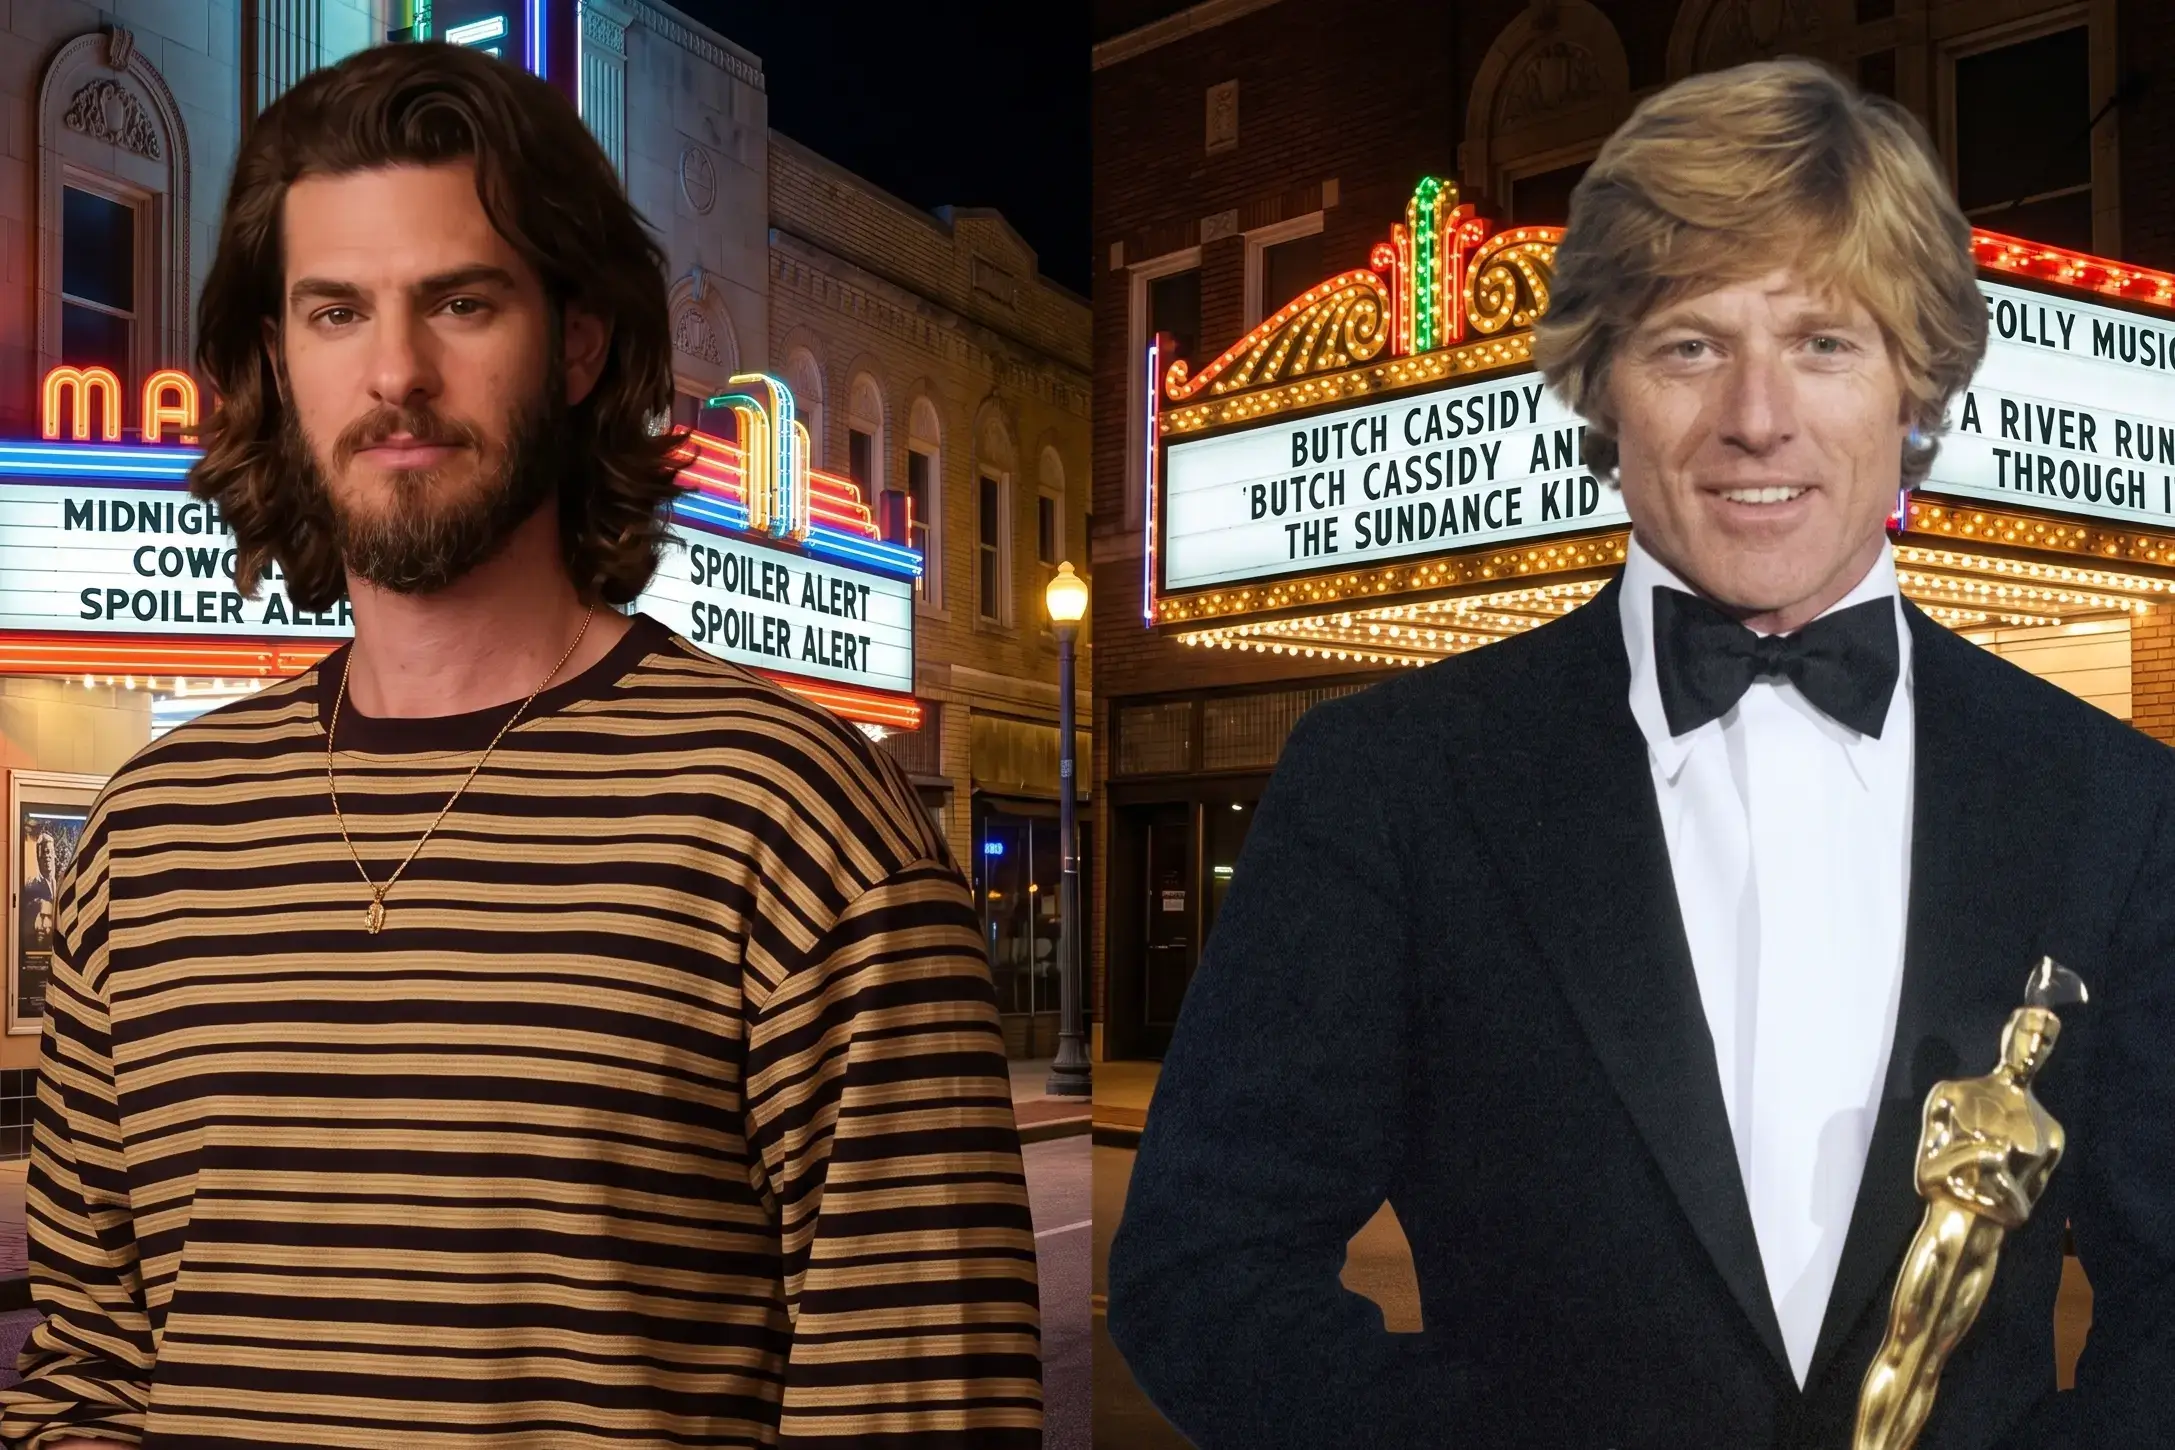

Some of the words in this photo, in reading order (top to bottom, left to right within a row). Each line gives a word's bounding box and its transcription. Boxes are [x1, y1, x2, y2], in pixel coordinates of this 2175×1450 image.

[42, 365, 222, 444] MA
[1292, 414, 1388, 468] BUTCH
[1404, 383, 1545, 447] CASSIDY
[1960, 391, 1982, 434] A
[2000, 398, 2098, 454] RIVER
[2115, 418, 2175, 466] RUN
[1363, 441, 1502, 501] CASSIDY
[1992, 447, 2146, 510] THROUGH
[2164, 474, 2175, 514] I
[64, 498, 228, 536] MIDNIGH
[1284, 516, 1339, 560] THE
[1354, 486, 1523, 550] SUNDANCE
[1541, 475, 1600, 522] KID
[134, 545, 284, 580] COW
[690, 543, 791, 605] SPOILER
[800, 571, 871, 622] ALERT
[80, 587, 245, 624] SPOILER
[262, 592, 356, 627] ALER
[691, 600, 792, 659] SPOILER
[801, 624, 871, 673] ALERT
